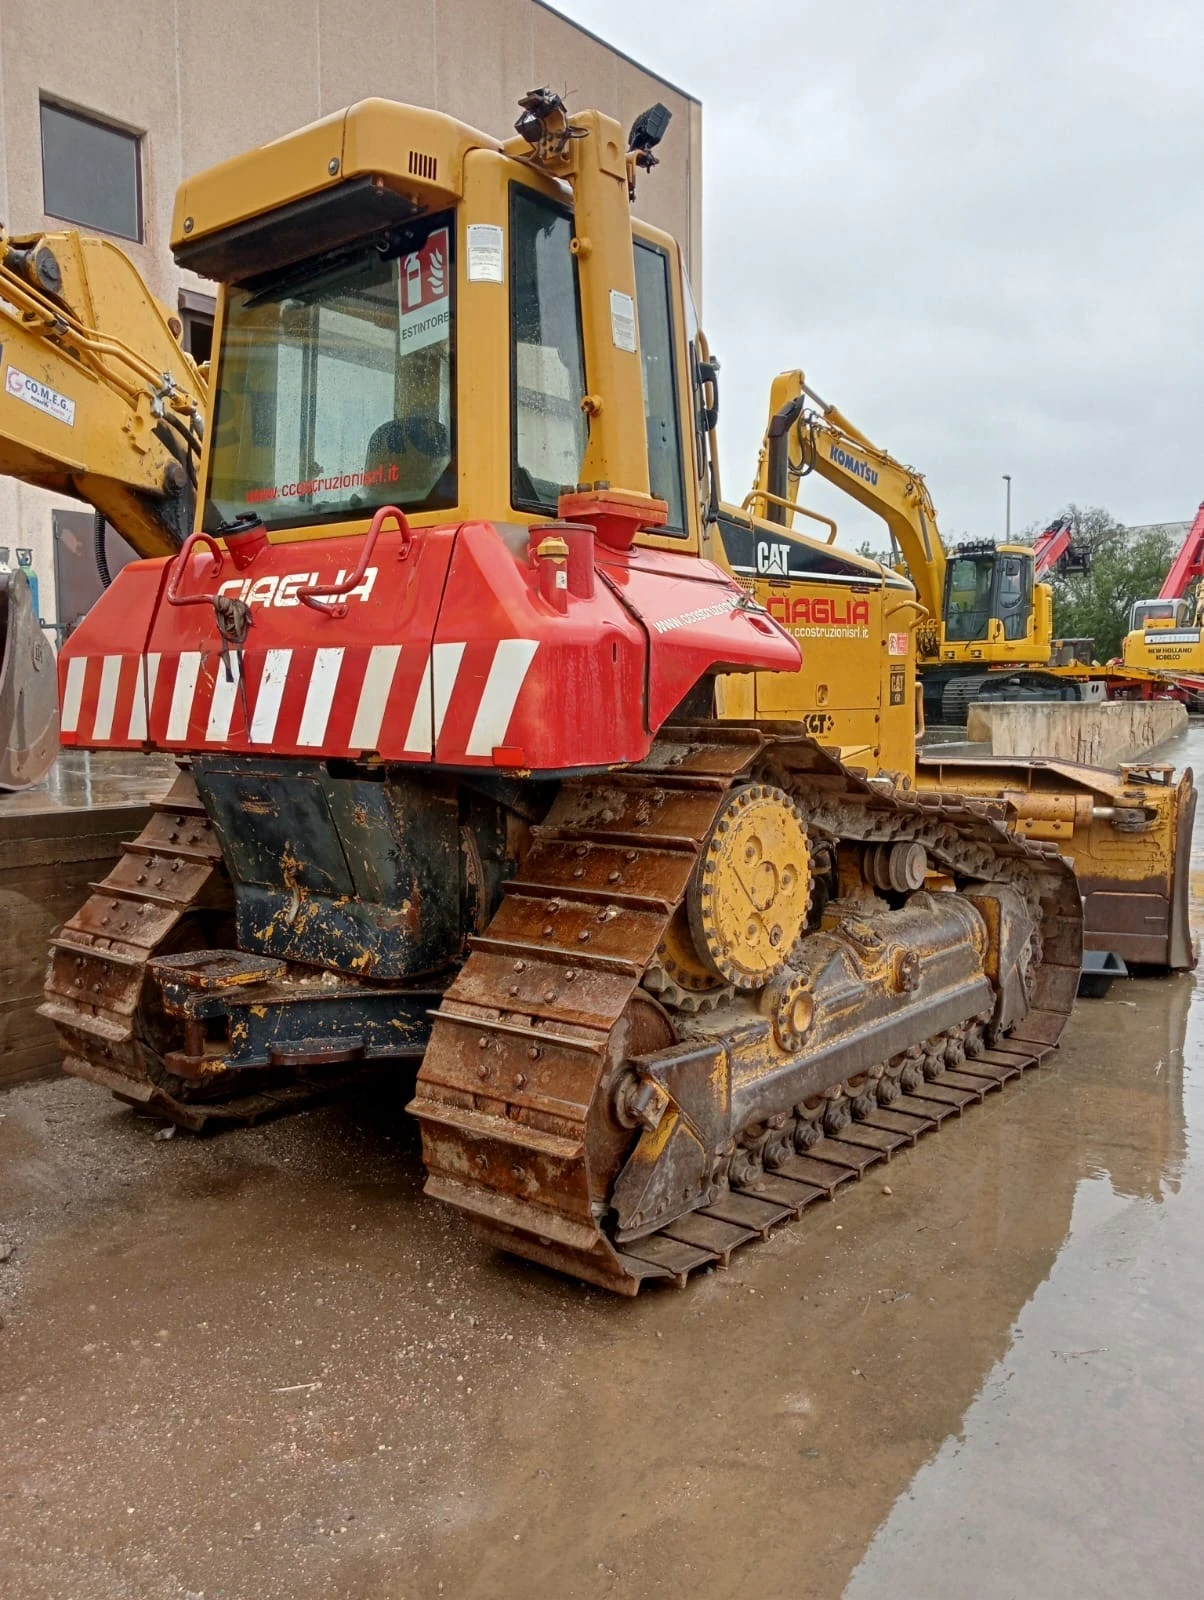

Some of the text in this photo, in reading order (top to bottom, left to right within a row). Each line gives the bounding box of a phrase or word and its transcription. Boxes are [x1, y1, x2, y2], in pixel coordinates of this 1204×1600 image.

[402, 311, 449, 340] ESTINTORE
[25, 379, 69, 411] CO.M.E.G.
[830, 445, 878, 486] KOMATSU
[757, 541, 791, 575] CAT
[217, 566, 378, 608] CIAGLIA
[767, 597, 869, 625] CIAGLIA
